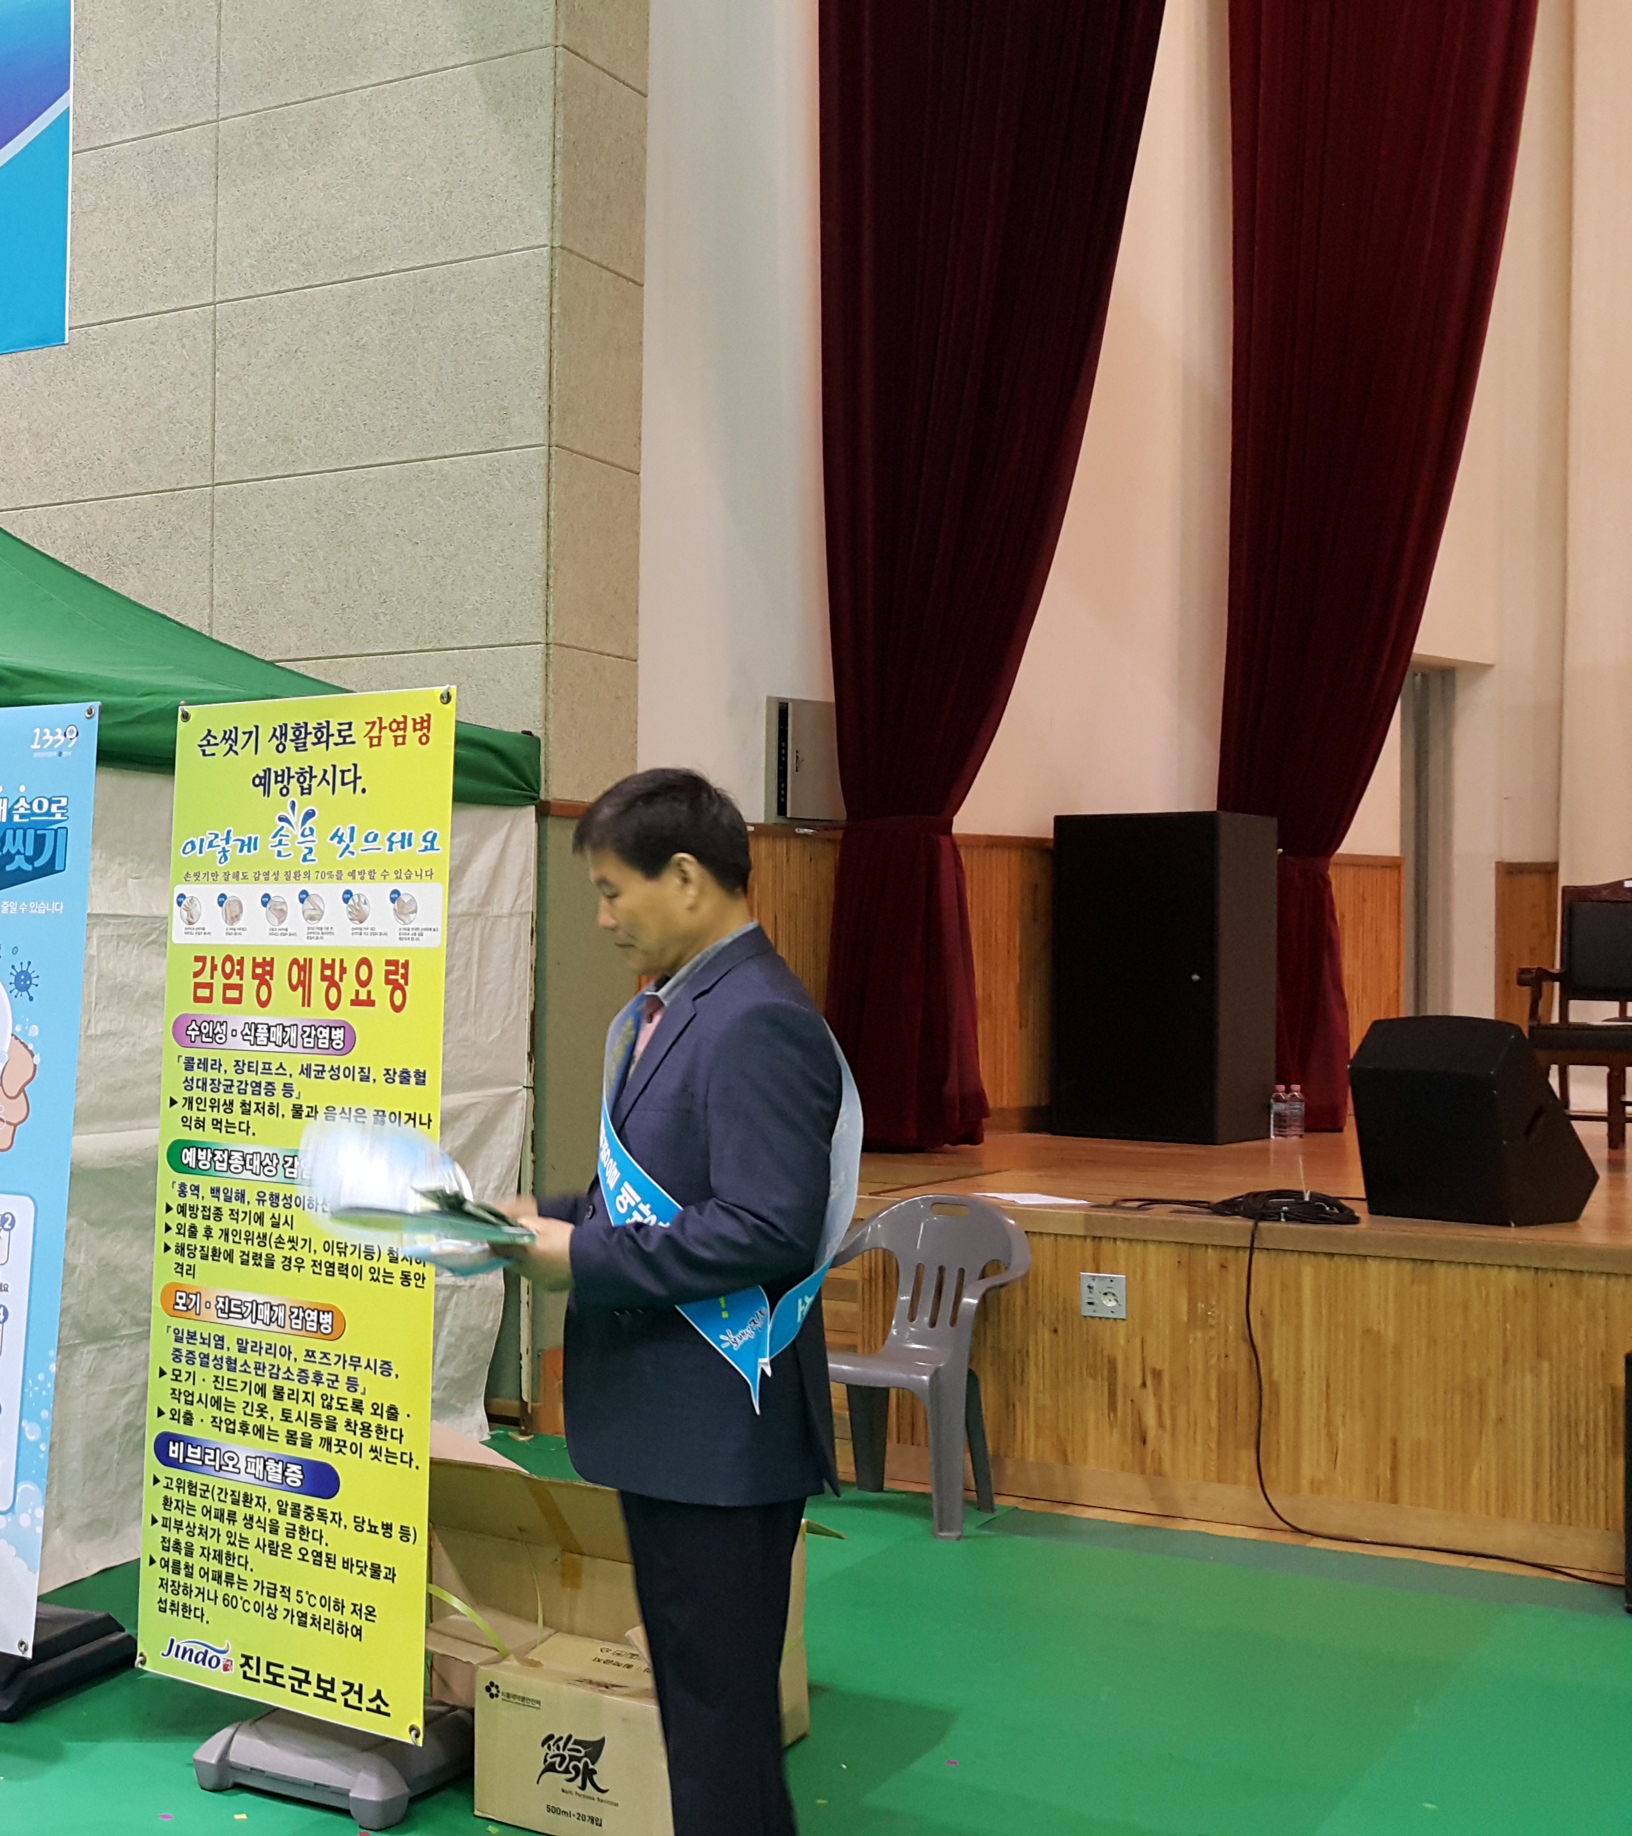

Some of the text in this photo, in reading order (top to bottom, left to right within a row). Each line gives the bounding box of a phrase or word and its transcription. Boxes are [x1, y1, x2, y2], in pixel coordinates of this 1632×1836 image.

[30, 725, 79, 749] 1339
[197, 713, 432, 758] 손씻기 생활화로 감염병
[252, 763, 367, 799] 예방합시다.
[13, 796, 68, 822] 손으로
[181, 824, 441, 865] 이렇게 손을 씻으세요
[183, 868, 434, 882] 손씻기만 잘해도 감염성 질환의 70%를 예방할 수 있습니다
[19, 902, 27, 914] 수
[29, 901, 63, 914] 있습니다
[192, 954, 410, 1013] 감염병 예방요령
[301, 1025, 345, 1050] 감염병
[182, 1076, 277, 1098] 성대장균감염증
[233, 1058, 293, 1078] 장티프스,
[299, 1062, 377, 1084] 세균성이질,
[382, 1067, 427, 1086] 장출혈
[180, 1115, 256, 1137] 익혀 먹는다.
[182, 1096, 432, 1130] 개인위생 철저히, 물과 음식은 끓이거나
[181, 1147, 279, 1177] 예방접종대상
[209, 1186, 251, 1205] 백일해,
[4, 1214, 12, 1228] 2
[176, 1203, 294, 1231] 예방접종 적기에 실시
[175, 1223, 199, 1240] 외출
[202, 1225, 214, 1240] 후
[323, 1238, 382, 1262] 이닦기등)
[173, 1262, 196, 1279] 격리
[174, 1242, 426, 1289] 해당질환에 걸렸을 경우 전염력이 있는 동안
[290, 1307, 333, 1334] 감염병
[170, 1348, 340, 1390] 중증열성혈소판감소증후군
[236, 1337, 298, 1363] 말라리아,
[303, 1348, 399, 1379] 쯔즈가무시증,
[212, 1374, 267, 1396] 진드기에
[272, 1384, 315, 1406] 물리지
[320, 1394, 365, 1415] 않도록
[169, 1388, 404, 1444] 작업시에는 긴옷, 토시등을 착용한다
[211, 1415, 280, 1442] 작업후에는
[285, 1429, 314, 1448] 몸을
[319, 1435, 363, 1459] 깨끗이
[368, 1446, 420, 1469] 씻는다.
[168, 1440, 304, 1488] 비브리오 패혈증
[161, 1495, 329, 1547] 환자는 어패류 생식을 금한다.
[277, 1498, 348, 1530] 알콜중독자,
[353, 1515, 394, 1540] 당뇨병
[398, 1524, 418, 1545] 등)
[160, 1536, 254, 1572] 접촉을 자제한다.
[161, 1515, 397, 1585] 피부상처가 있는 사람은 오염된 바닷물과
[159, 1557, 195, 1578] 여름철
[198, 1565, 249, 1591] 어패류는
[253, 1577, 292, 1602] 가급적
[350, 1601, 377, 1623] 저온
[157, 1577, 219, 1604] 저장하거나
[282, 1606, 363, 1642] 가열처리하여
[157, 1597, 210, 1624] 섭취한다.
[161, 1637, 221, 1670] Jindo
[239, 1653, 391, 1717] 진도군보건소
